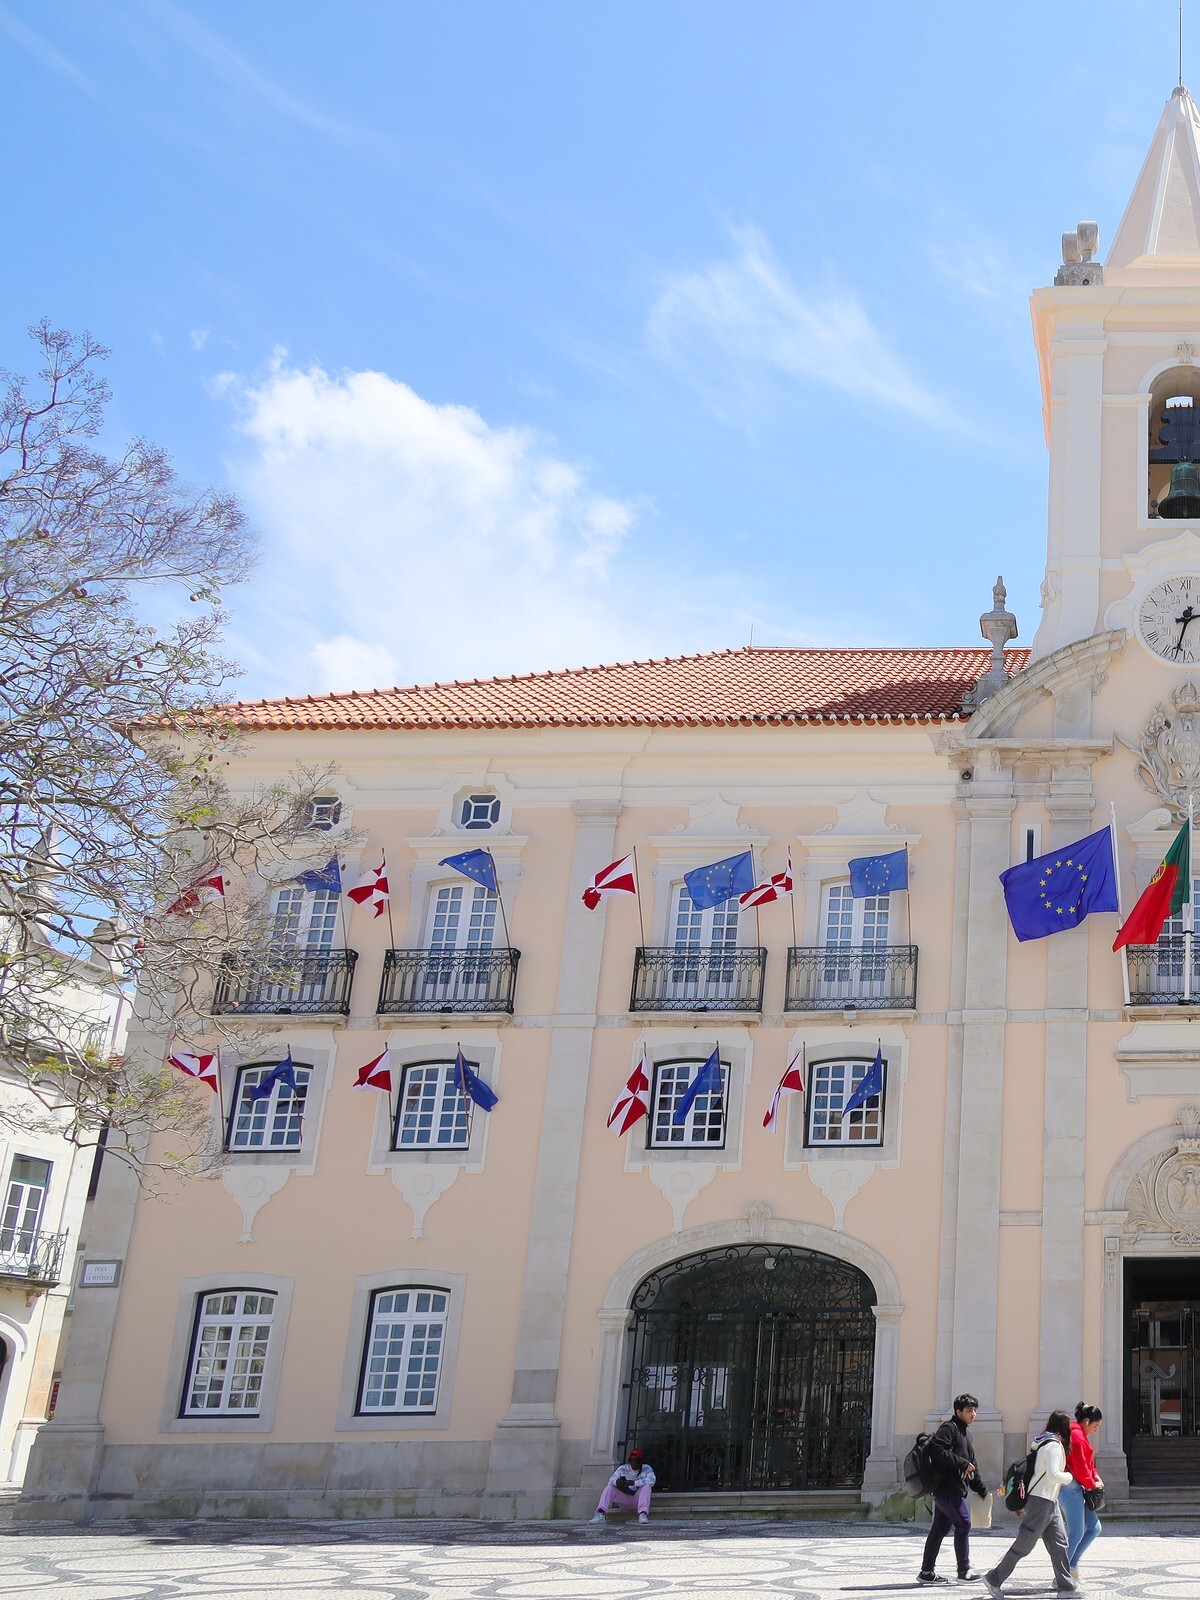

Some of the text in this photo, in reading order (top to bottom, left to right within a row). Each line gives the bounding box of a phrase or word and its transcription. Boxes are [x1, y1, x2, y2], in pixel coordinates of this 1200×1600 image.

[1180, 579, 1191, 590] XII
[1161, 584, 1173, 596] XI
[1171, 595, 1181, 605] 23
[1160, 604, 1171, 614] 22
[1161, 626, 1171, 636] 20
